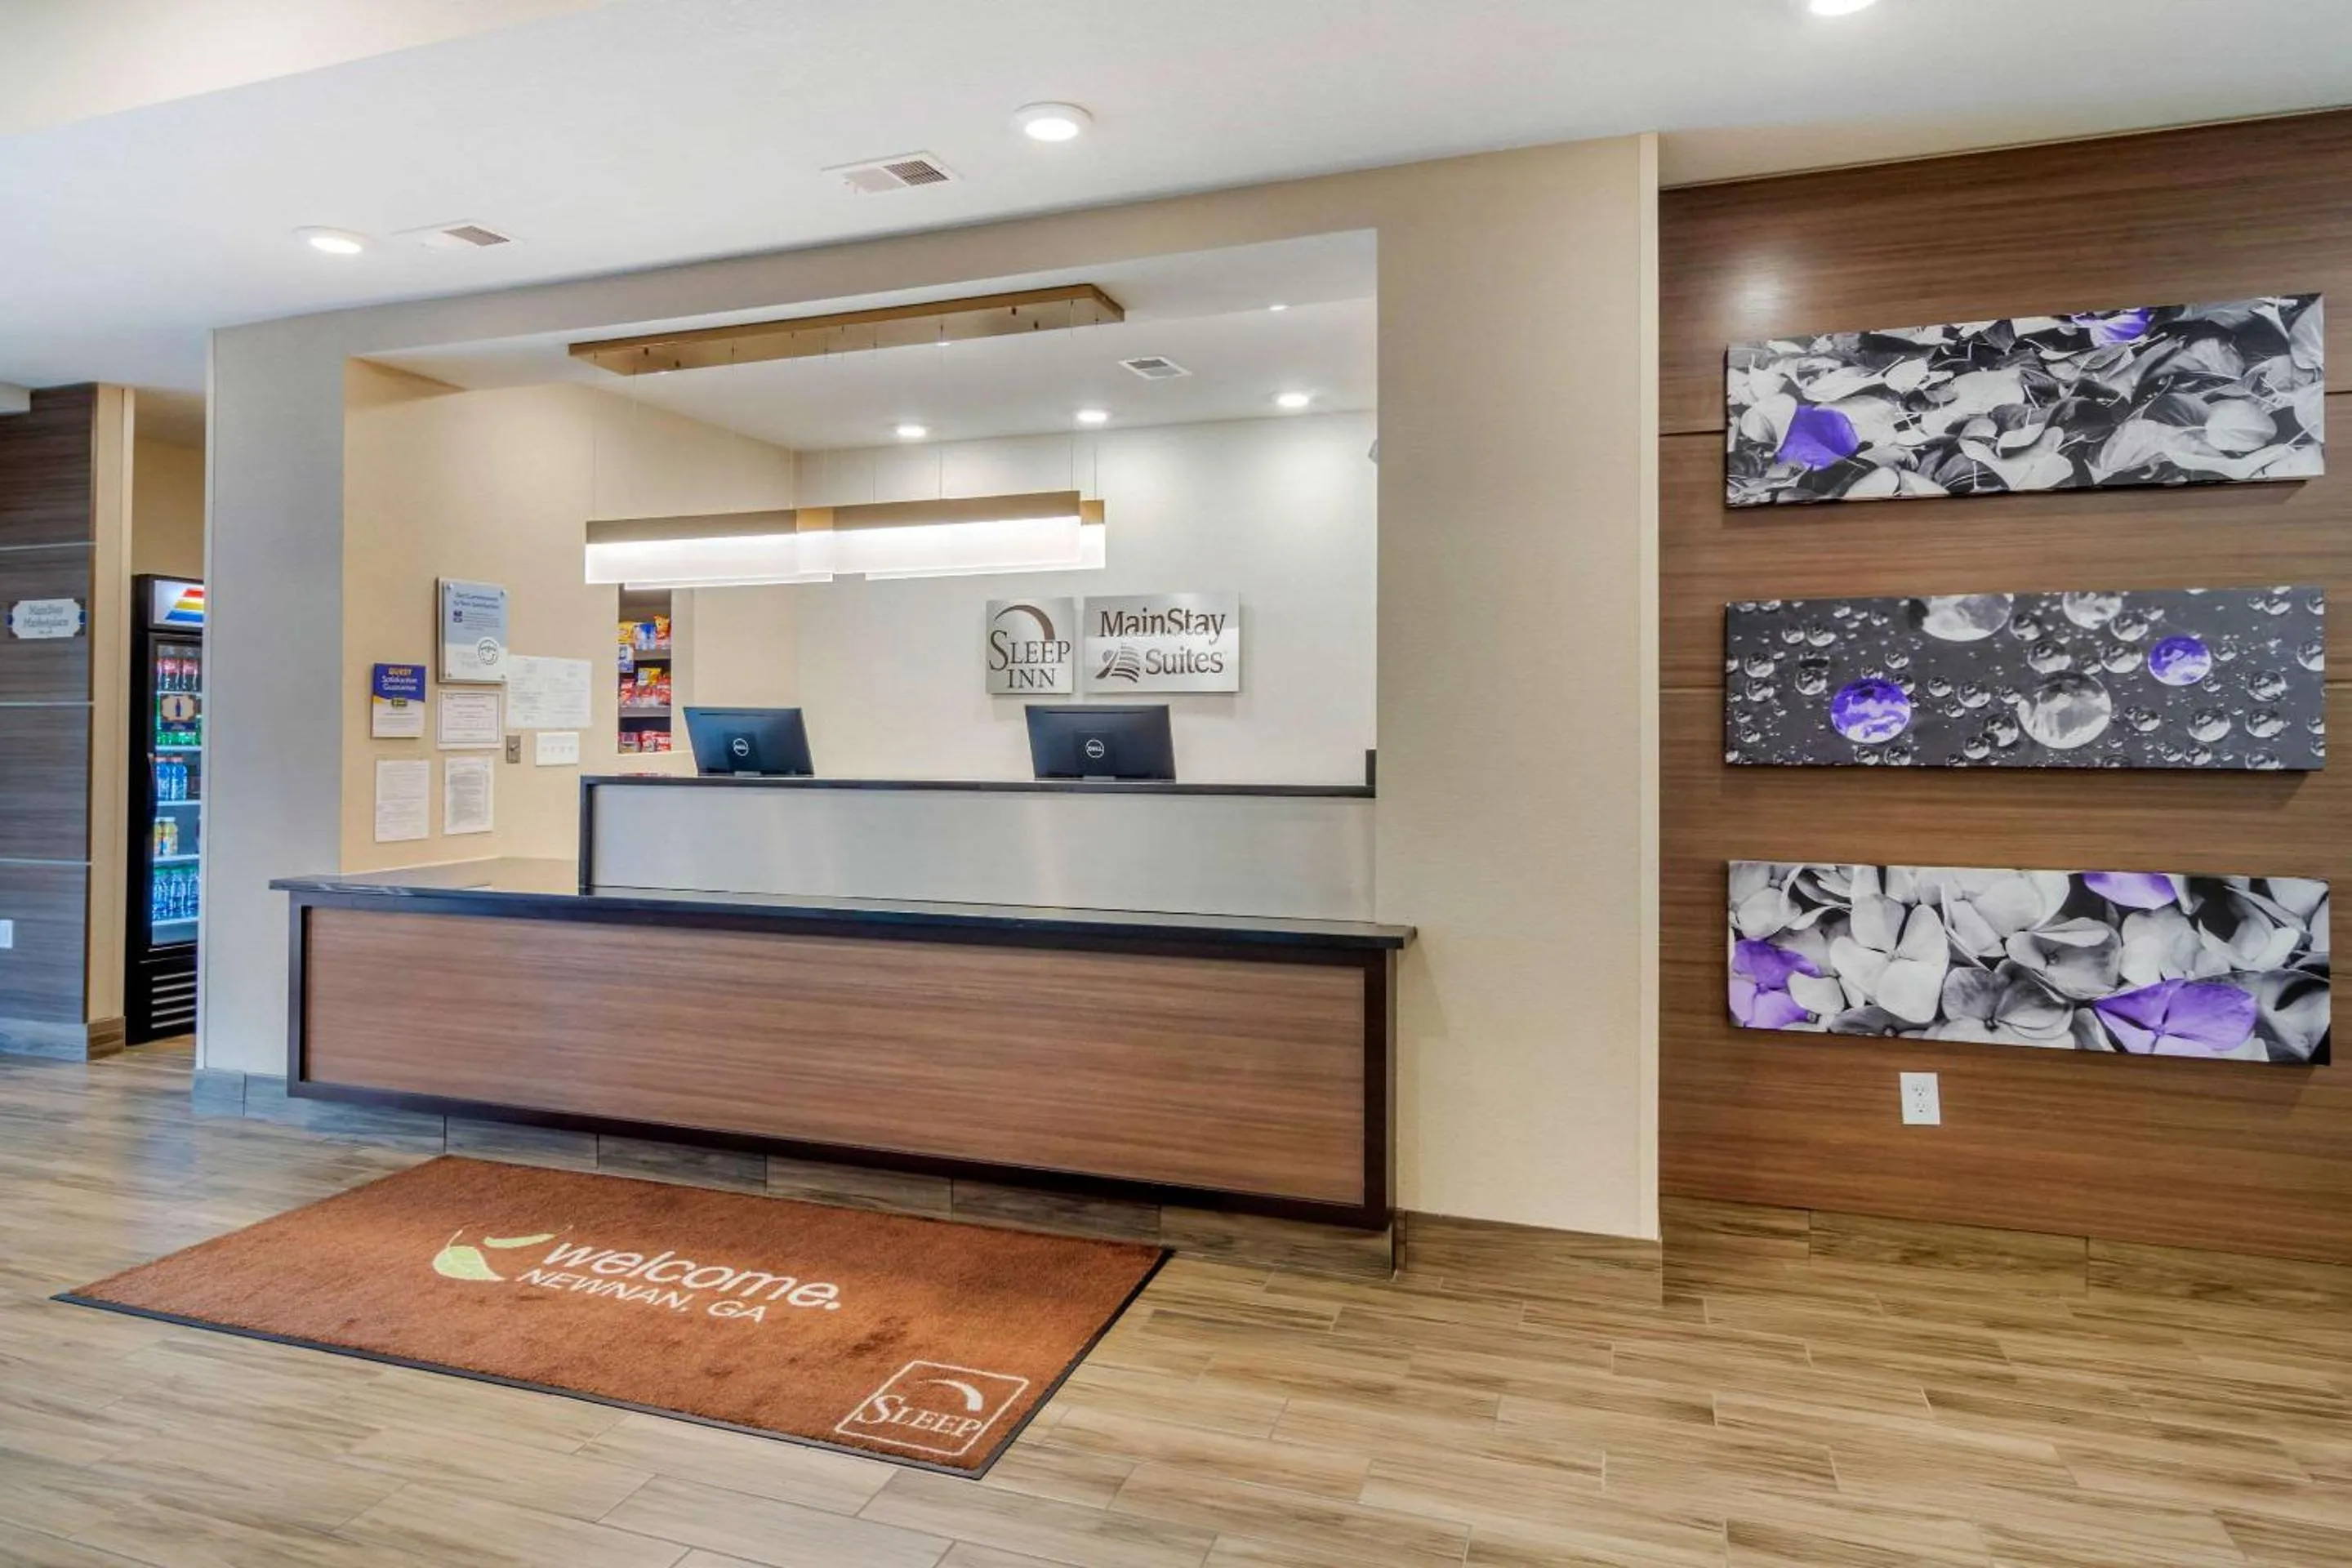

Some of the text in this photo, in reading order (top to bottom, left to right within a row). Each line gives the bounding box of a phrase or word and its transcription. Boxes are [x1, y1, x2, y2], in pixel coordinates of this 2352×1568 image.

[1099, 607, 1227, 645] MainStay
[988, 630, 1071, 671] SLEEP
[1144, 645, 1225, 675] Suites
[1006, 668, 1056, 689] INN
[515, 1268, 768, 1323] NEWNAN, GA
[542, 1242, 842, 1310] welcome.
[854, 1394, 983, 1437] SLEEP
